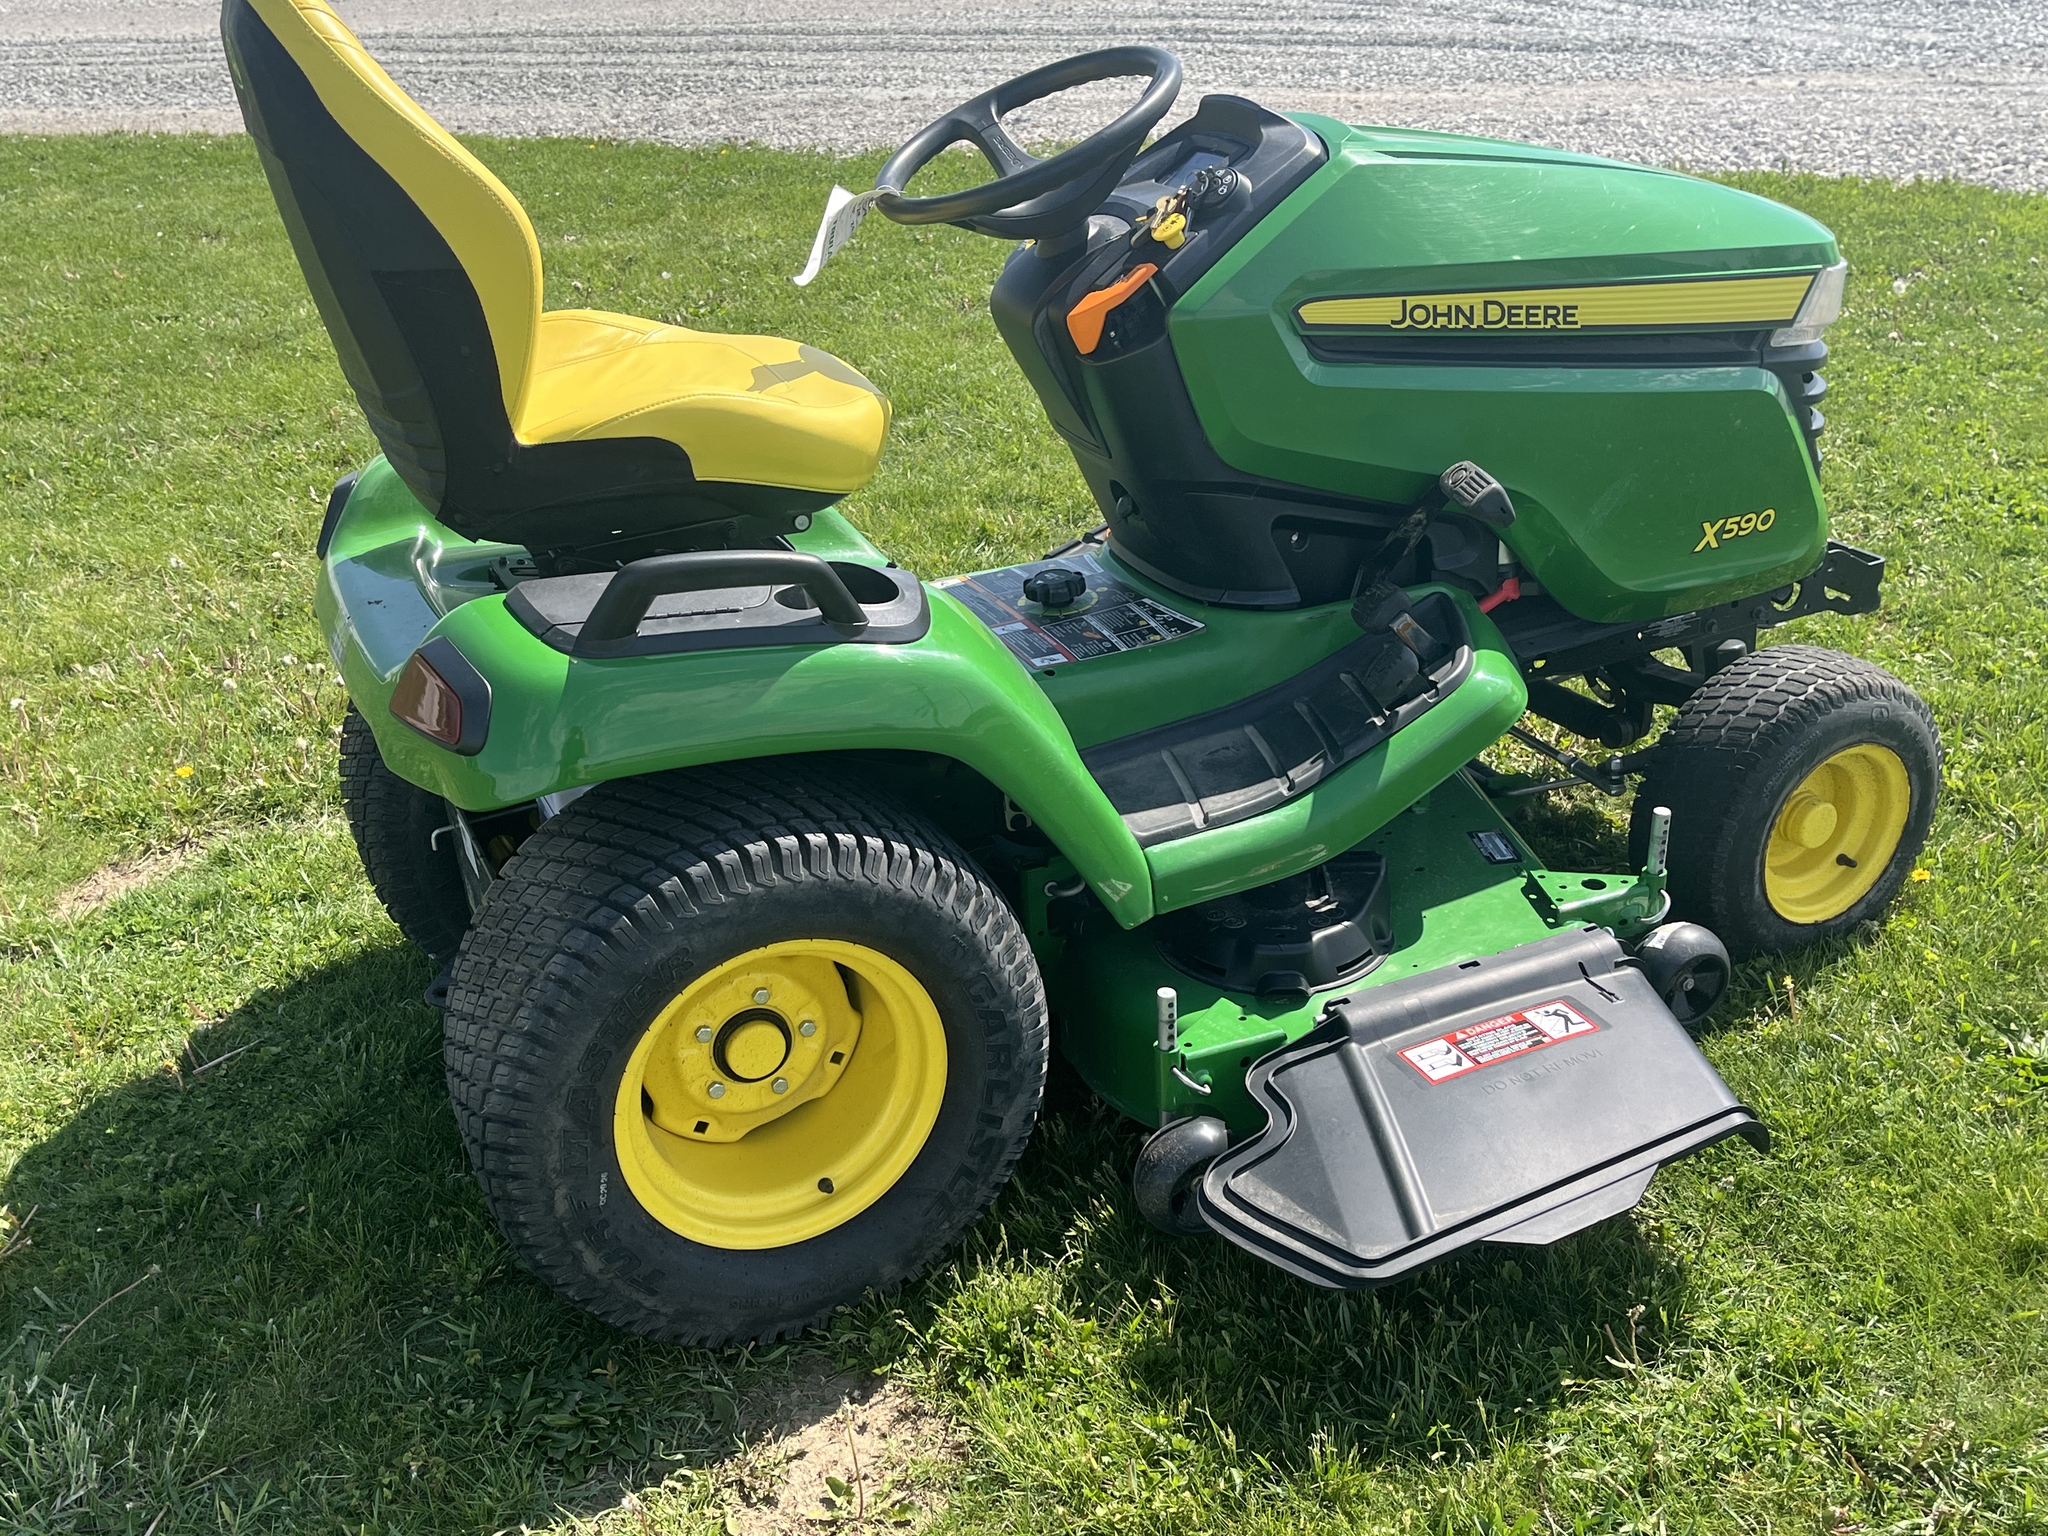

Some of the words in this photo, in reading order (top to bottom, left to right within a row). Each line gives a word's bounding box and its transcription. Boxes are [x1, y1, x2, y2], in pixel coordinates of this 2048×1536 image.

[1390, 299, 1475, 326] JOHN
[1482, 300, 1579, 326] DEERE
[1692, 507, 1777, 553] X590
[1465, 1015, 1517, 1035] DANGER
[561, 944, 697, 1177] MASTER
[1481, 1081, 1508, 1095] DO
[1507, 1068, 1541, 1086] NOT
[922, 971, 1012, 1233] CARLISLE
